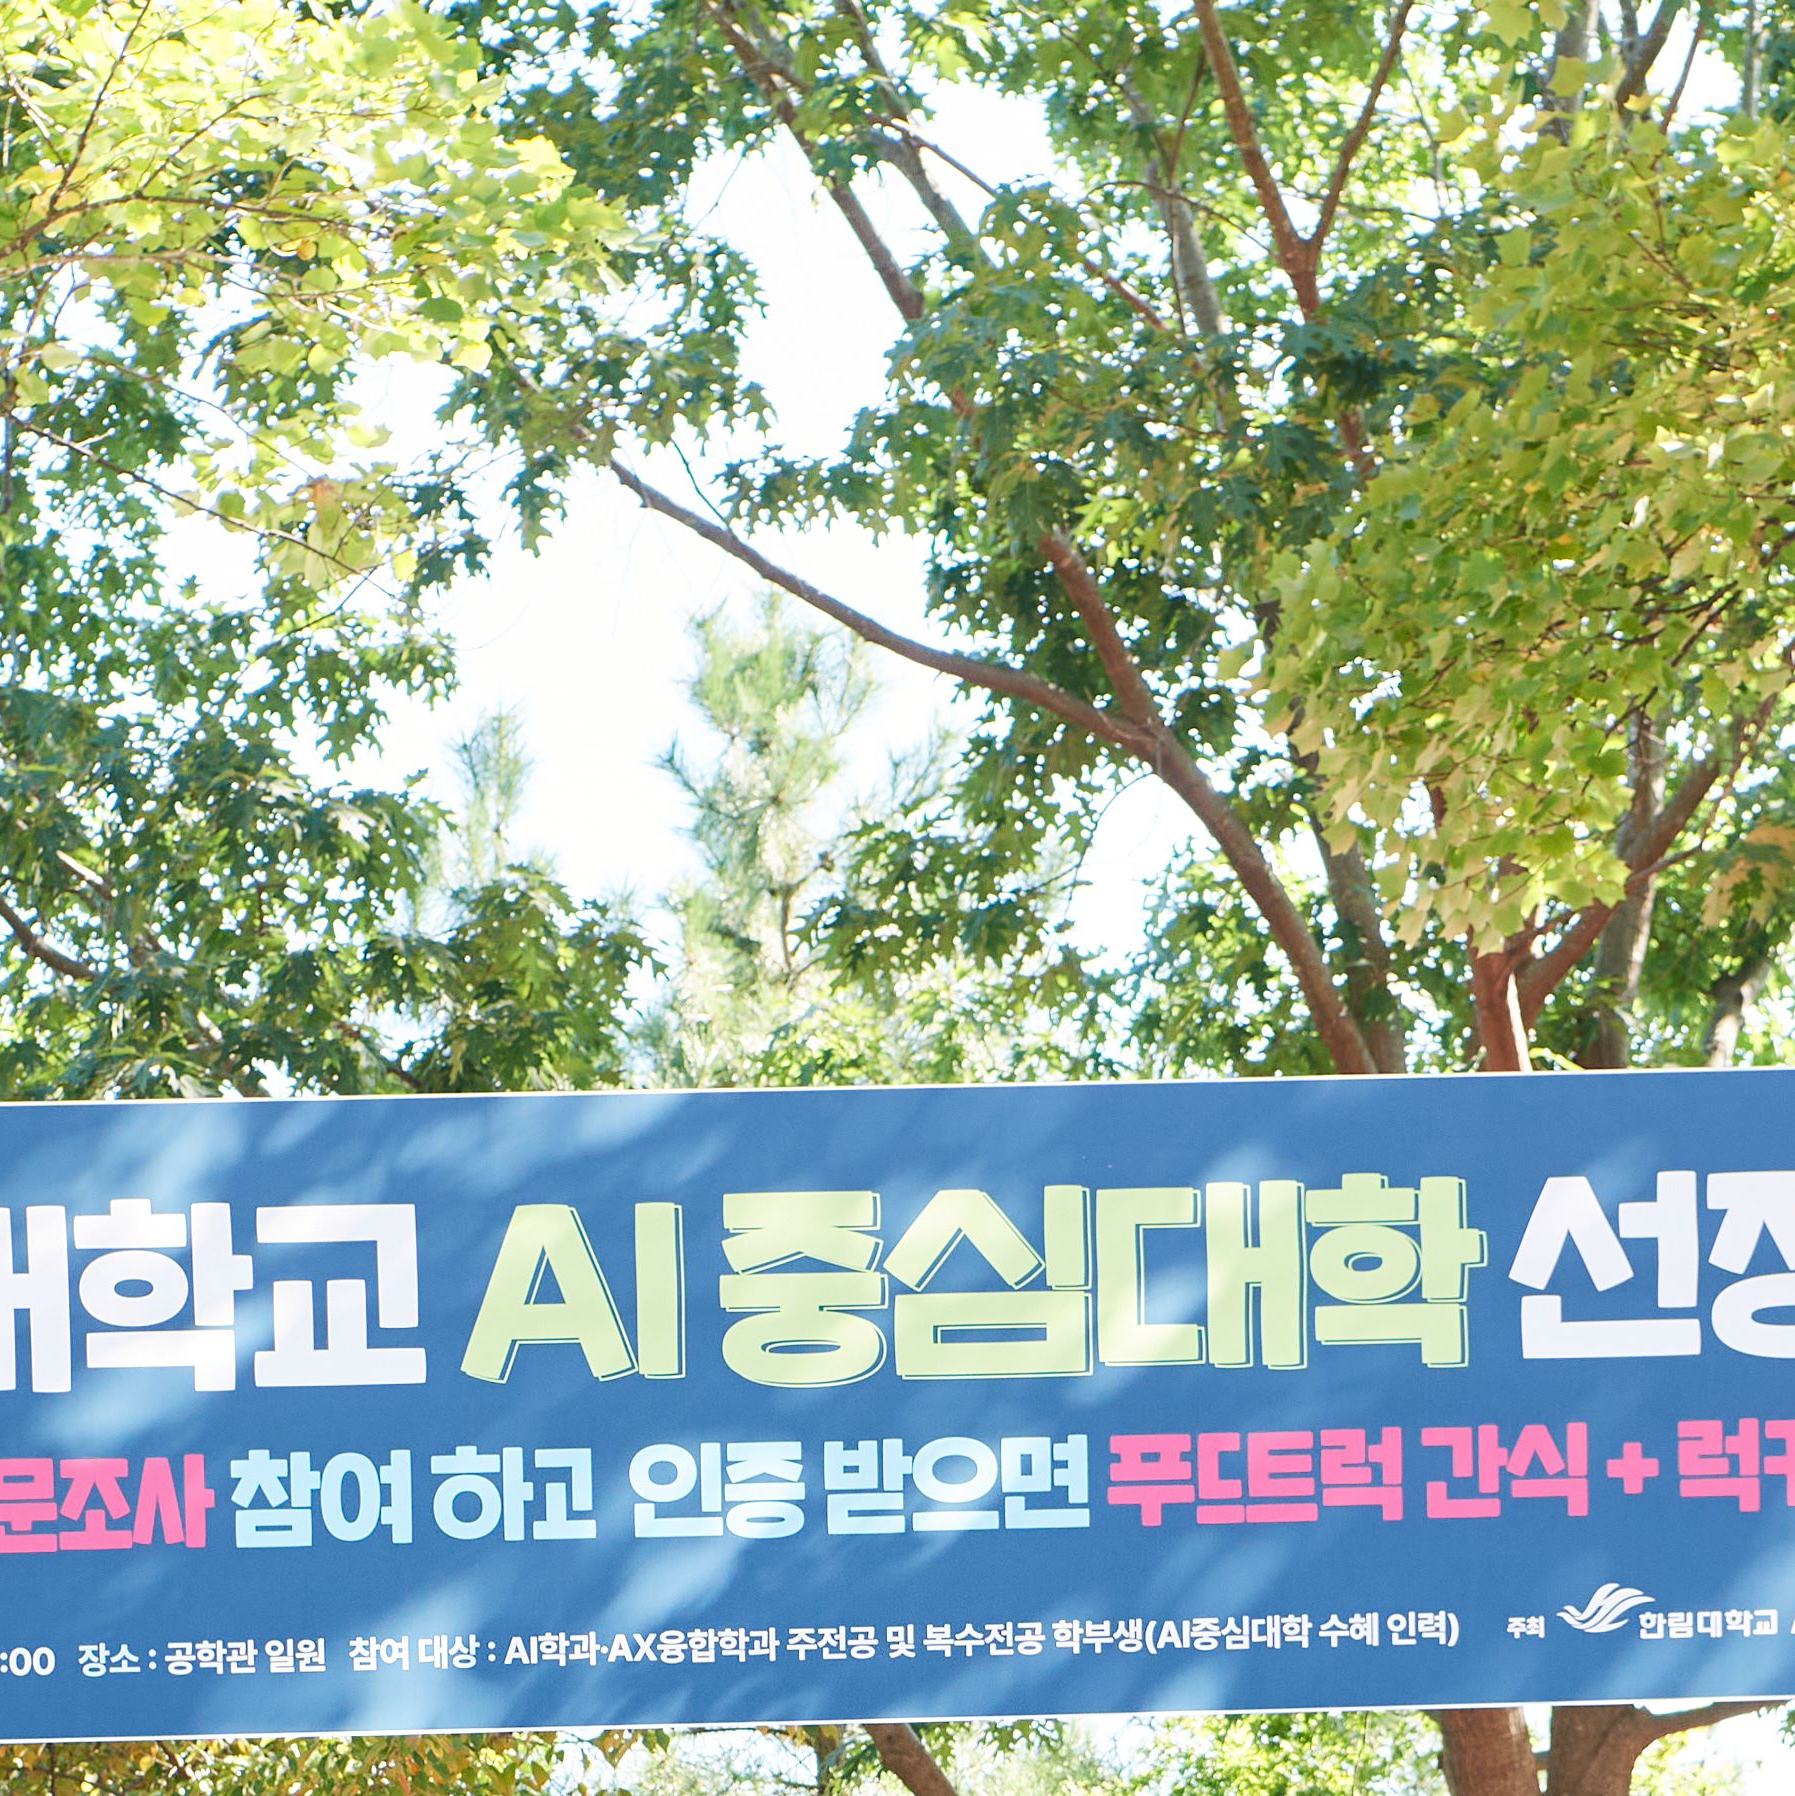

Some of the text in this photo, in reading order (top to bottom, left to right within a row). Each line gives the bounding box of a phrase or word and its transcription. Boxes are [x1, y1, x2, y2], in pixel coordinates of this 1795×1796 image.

[461, 1202, 687, 1382] AI
[718, 1173, 1485, 1386] 중심대학
[231, 1449, 410, 1546] 참여
[432, 1443, 596, 1542] 하고
[631, 1438, 806, 1536] 인증
[825, 1434, 1088, 1531] 받으면
[1109, 1427, 1407, 1528] 푸드트럭
[1420, 1423, 1587, 1520] 간식
[1608, 1452, 1653, 1494] +
[77, 1643, 140, 1676] 장소
[164, 1641, 258, 1674] 공학관
[265, 1639, 326, 1673] 일원
[348, 1636, 411, 1670] 참여
[418, 1635, 480, 1668] 대상
[504, 1625, 777, 1666] AI학과·AX융합학과
[787, 1623, 878, 1660] 주전공
[886, 1624, 916, 1659] 및
[923, 1620, 1044, 1657] 복수전공
[1053, 1614, 1312, 1655] 학부생(AI중심대학
[1318, 1613, 1379, 1647] 수혜
[1386, 1611, 1459, 1645] 인력)
[1506, 1616, 1546, 1640] 주최
[1638, 1606, 1777, 1637] 한림대학교
